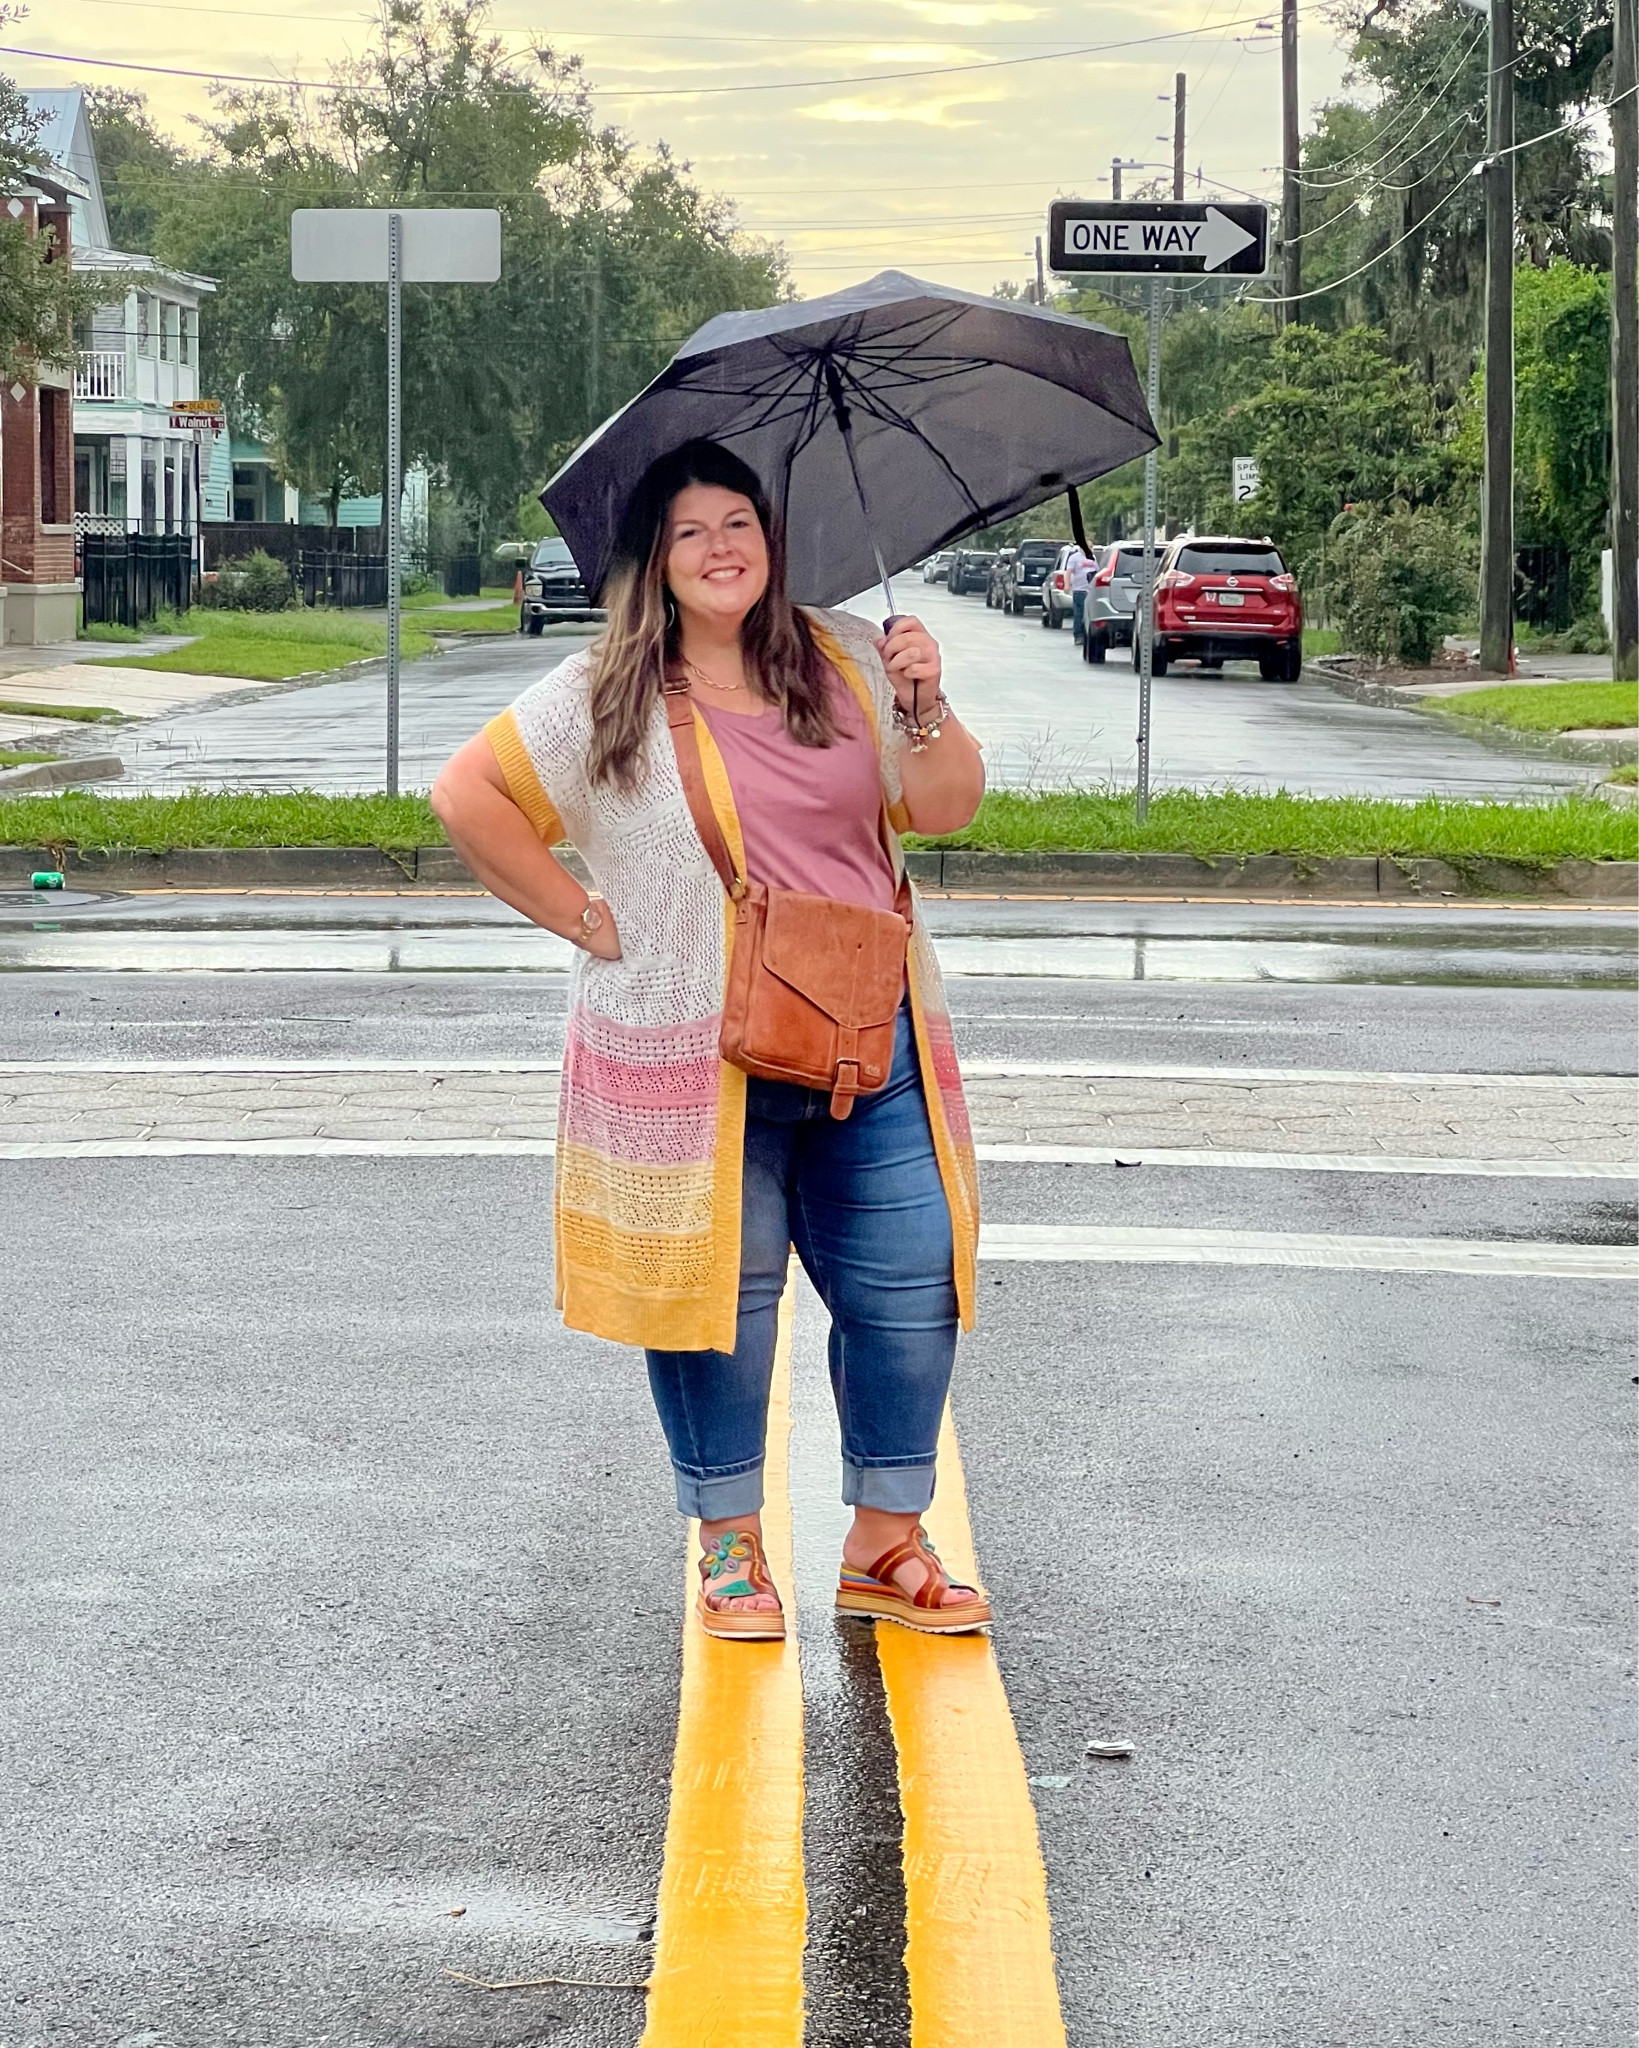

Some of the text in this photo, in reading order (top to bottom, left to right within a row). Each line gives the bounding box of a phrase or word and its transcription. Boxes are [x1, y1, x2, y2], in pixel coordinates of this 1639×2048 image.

[1073, 224, 1202, 252] ONE WAY
[178, 416, 212, 428] Walnut
[1238, 485, 1252, 502] 2
